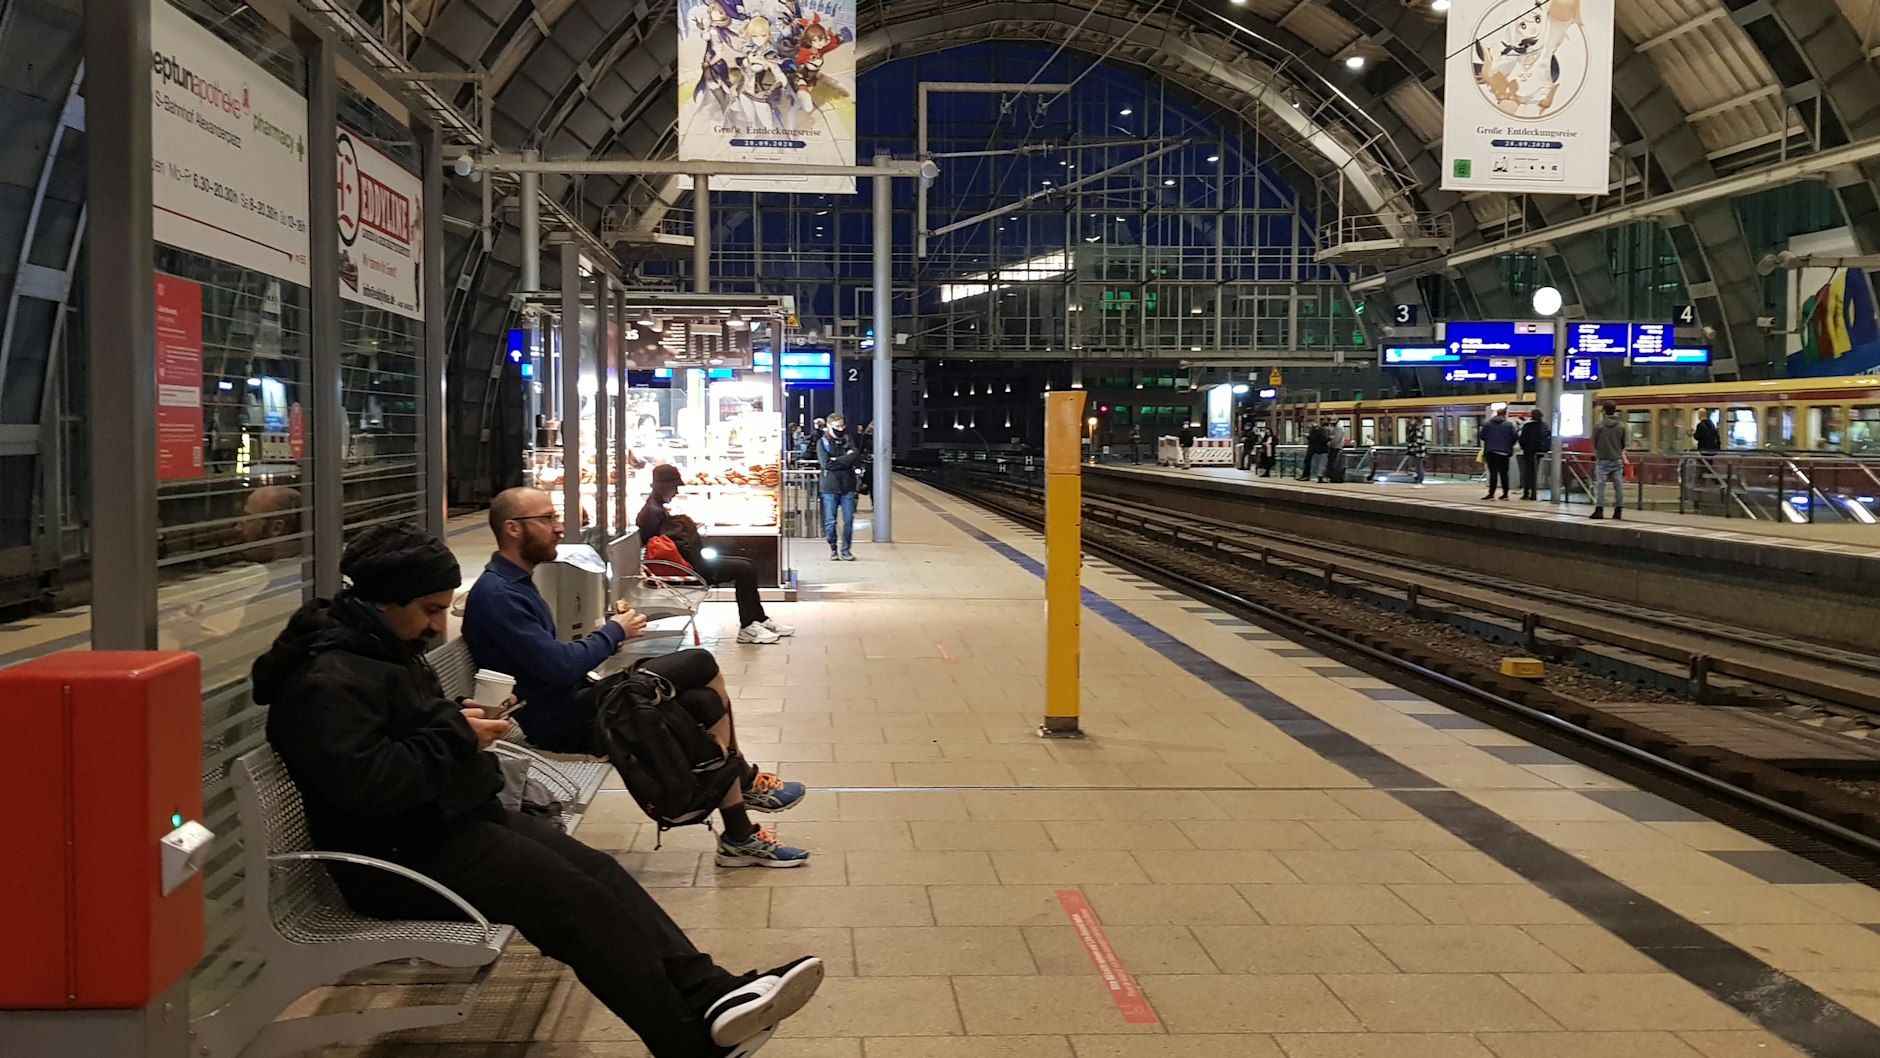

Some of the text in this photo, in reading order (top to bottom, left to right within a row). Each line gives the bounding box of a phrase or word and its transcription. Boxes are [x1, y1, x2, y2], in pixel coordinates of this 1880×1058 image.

[152, 50, 241, 119] eptunapotheke
[253, 112, 295, 154] pharmacy
[714, 125, 821, 137] Große Entdeckungsreise
[1476, 125, 1578, 138] Große Entdeckungsreise
[362, 181, 408, 239] EDDYLINE
[1396, 304, 1410, 323] 3
[1680, 305, 1693, 323] 4
[848, 368, 858, 382] 2
[999, 464, 1006, 472] H
[1025, 455, 1033, 465] H
